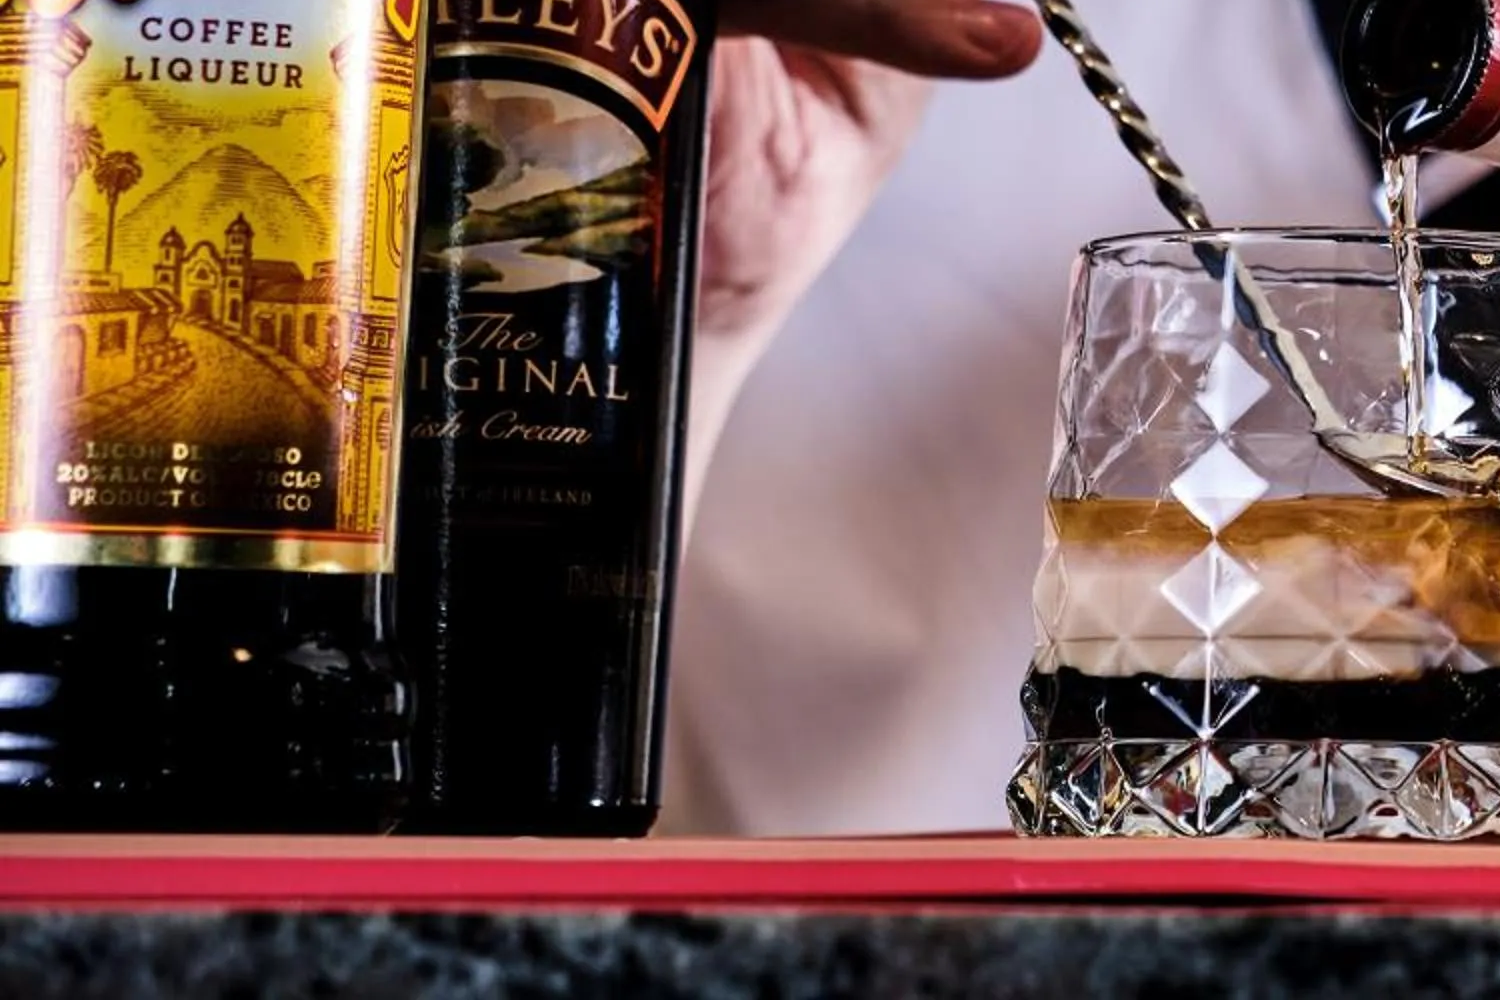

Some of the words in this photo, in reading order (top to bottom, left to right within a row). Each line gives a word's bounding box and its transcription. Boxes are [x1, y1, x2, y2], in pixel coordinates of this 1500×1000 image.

[140, 16, 293, 48] COFFEE
[125, 55, 304, 90] LIQUEUR
[437, 313, 544, 350] The
[419, 356, 629, 401] IGINAL
[410, 410, 465, 440] ish
[481, 410, 593, 445] Cream
